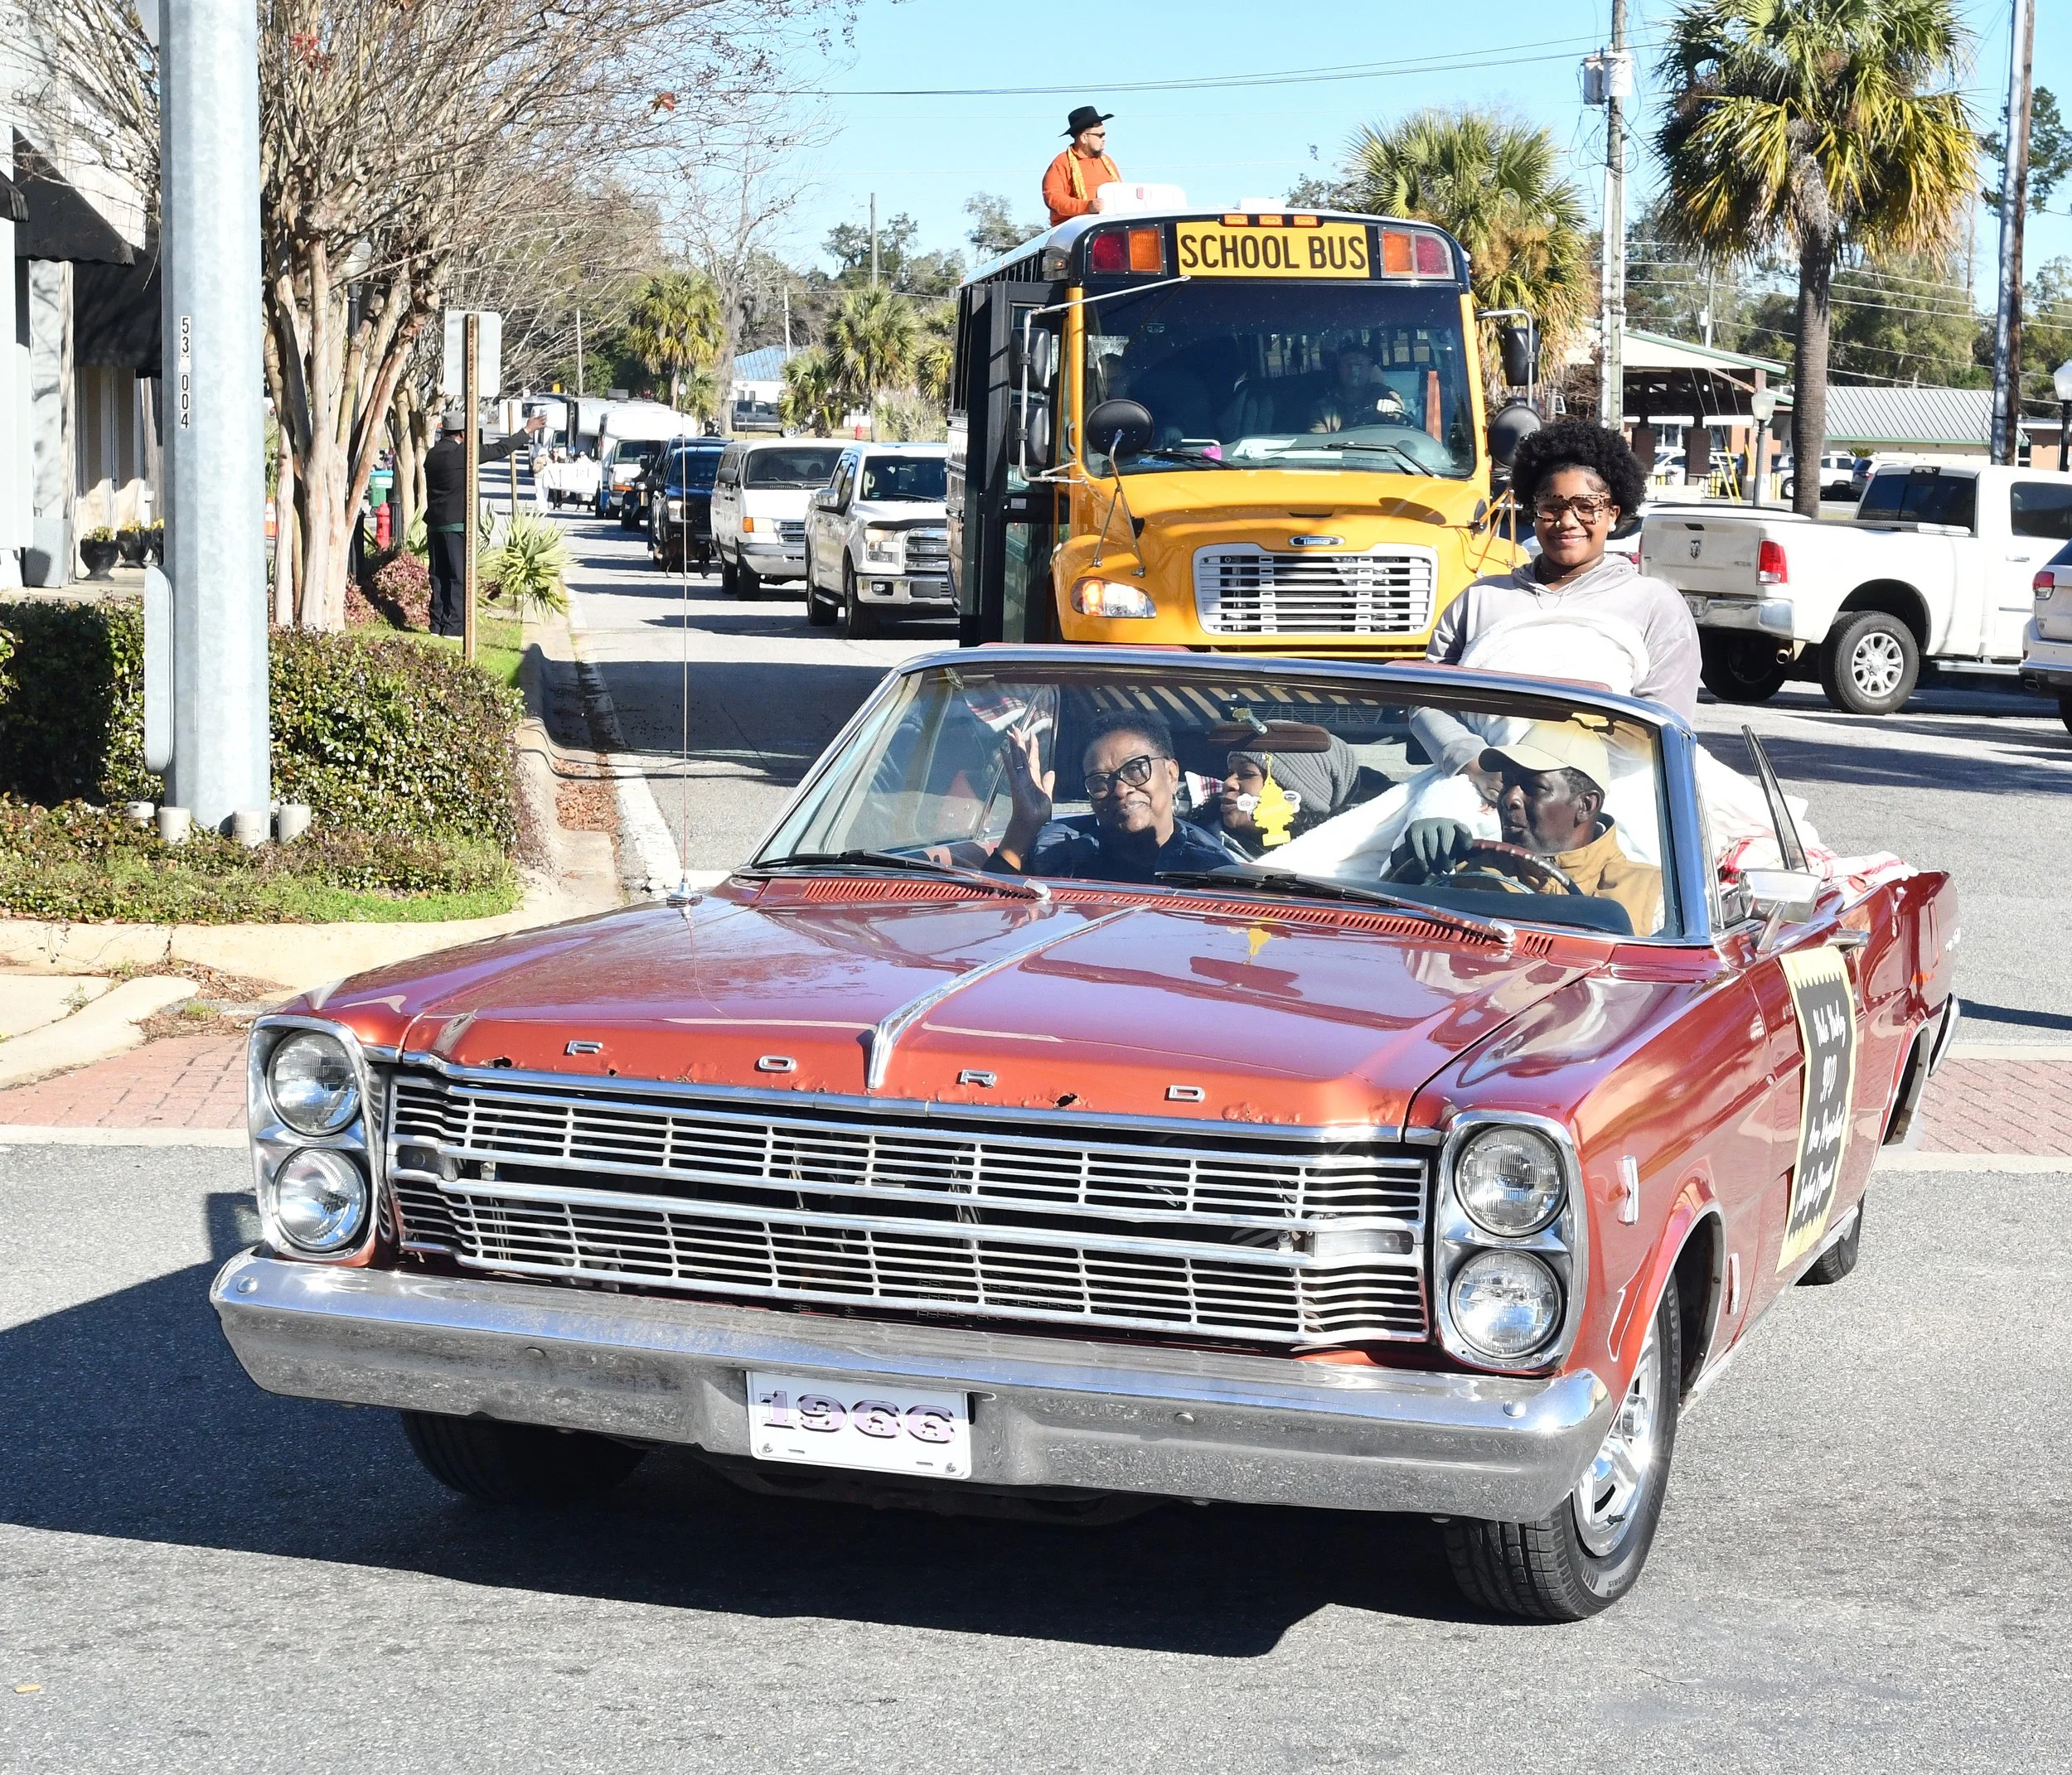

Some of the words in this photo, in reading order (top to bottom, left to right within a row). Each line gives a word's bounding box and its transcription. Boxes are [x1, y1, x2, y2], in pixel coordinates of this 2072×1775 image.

[1180, 235, 1300, 268] SCHOOL
[1308, 236, 1366, 269] BUS
[759, 1390, 955, 1444] 1966
